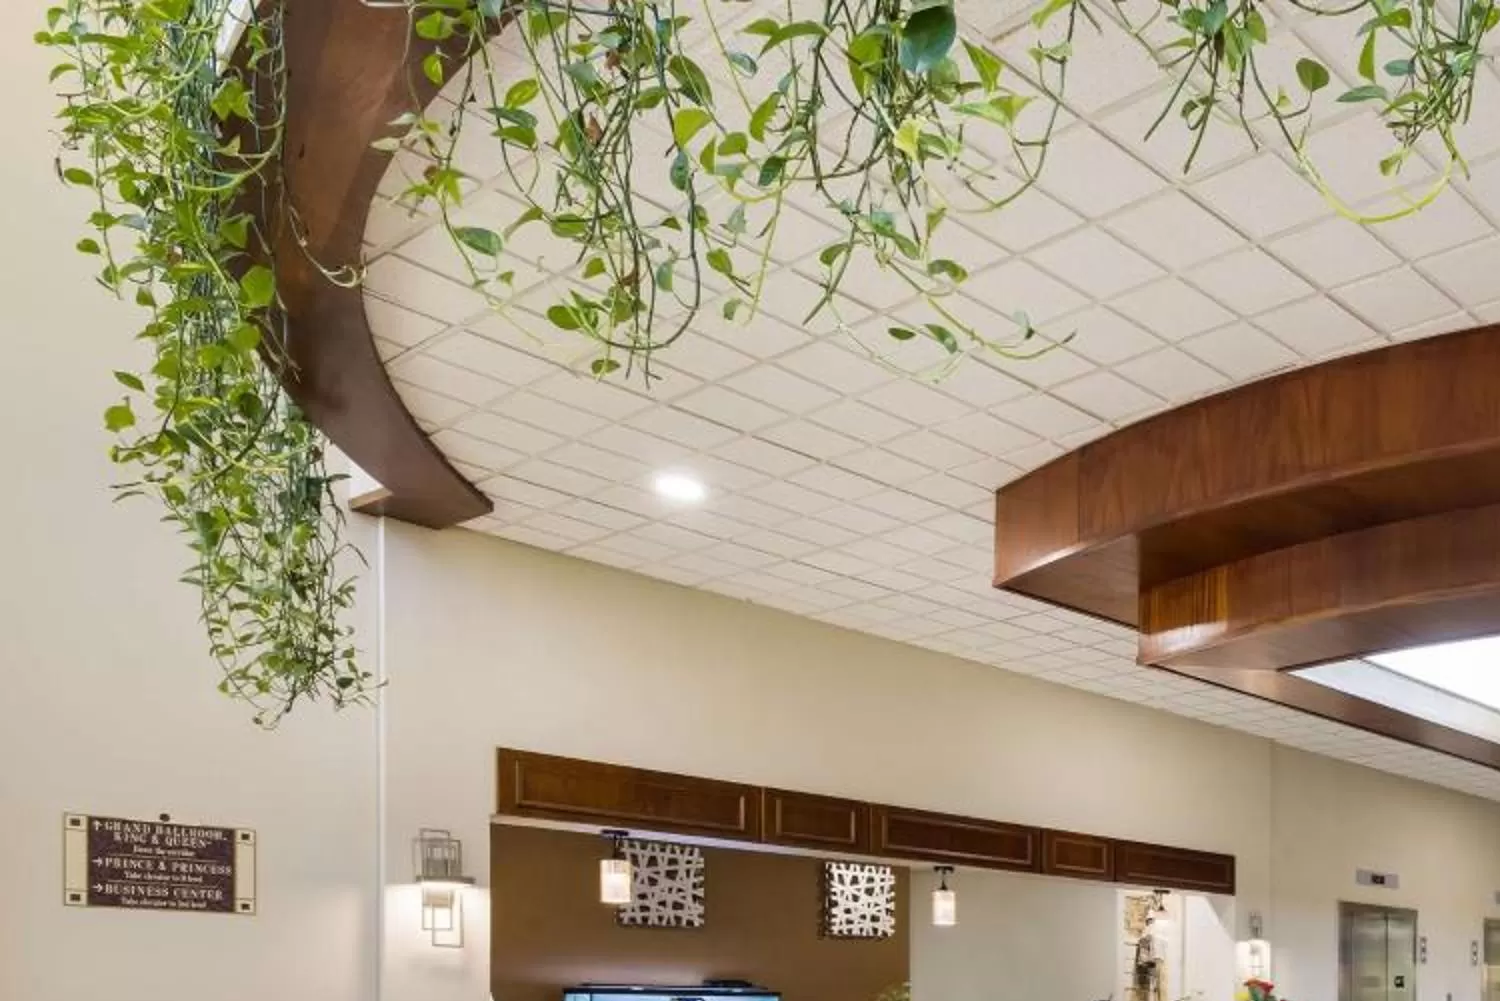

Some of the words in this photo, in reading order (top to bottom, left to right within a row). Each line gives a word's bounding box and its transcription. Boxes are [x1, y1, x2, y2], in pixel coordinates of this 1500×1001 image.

[104, 821, 151, 834] GRAND
[113, 832, 147, 843] KING
[151, 835, 160, 846] &
[105, 857, 153, 871] PRINCE
[158, 861, 167, 871] &
[171, 862, 232, 876] PRINCESS
[104, 884, 169, 897] BUSINESS
[173, 887, 223, 901] CENTER
